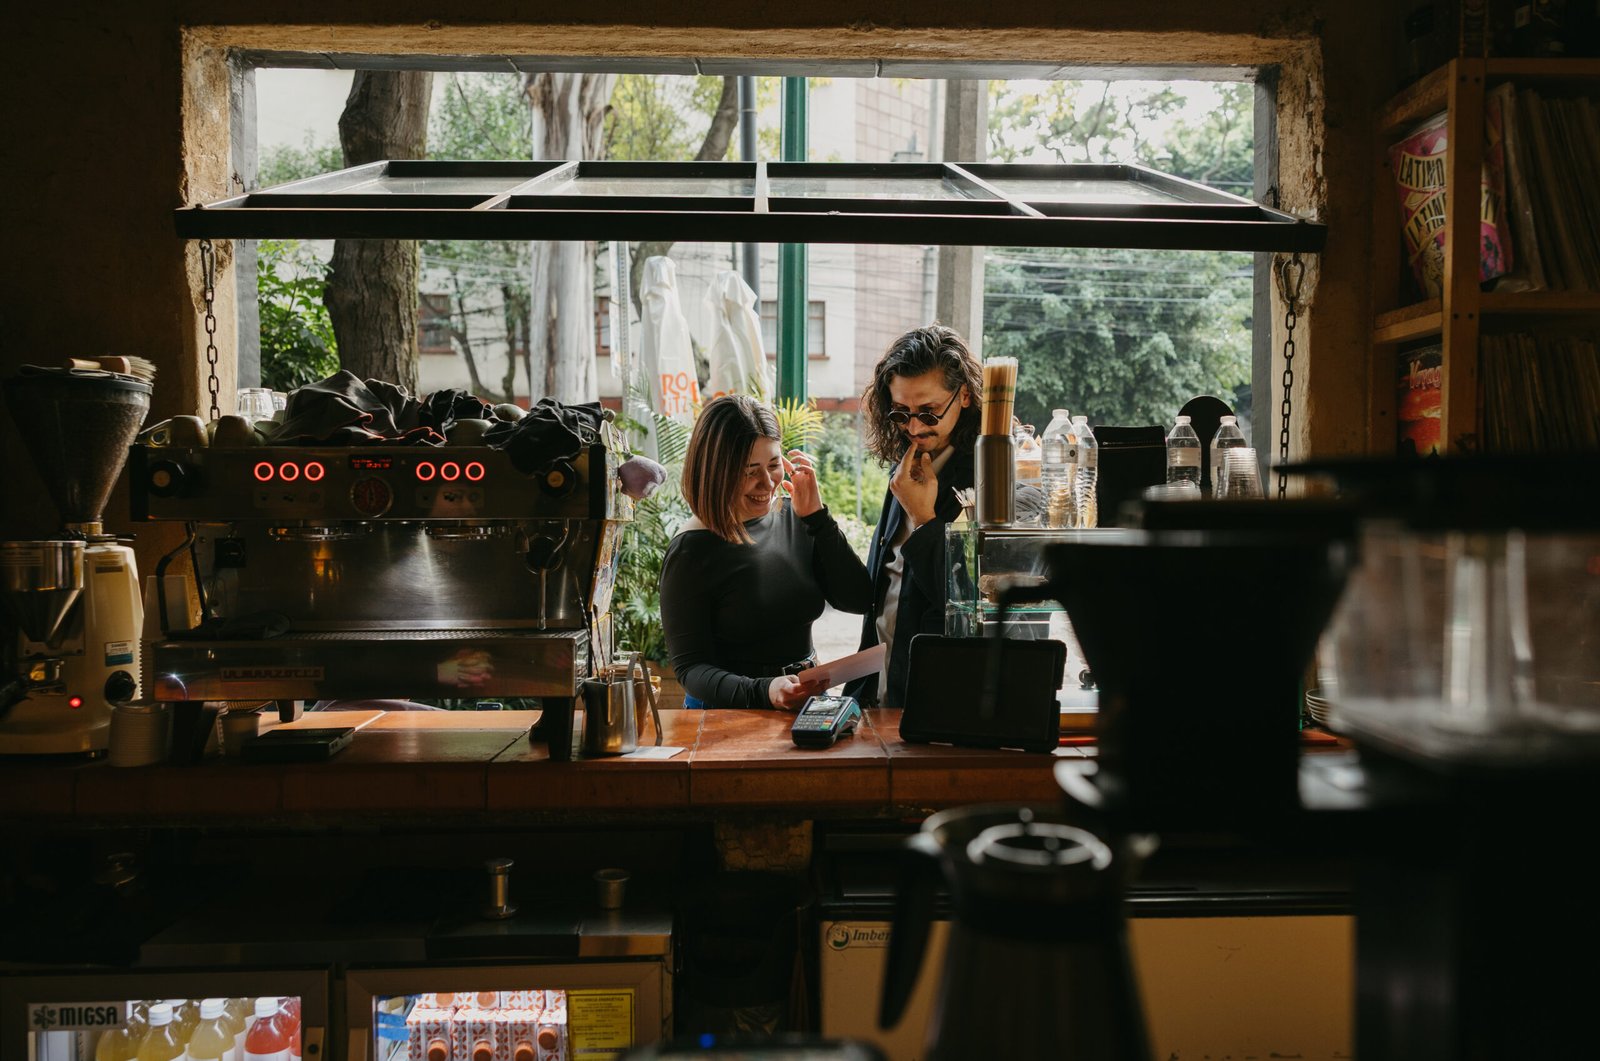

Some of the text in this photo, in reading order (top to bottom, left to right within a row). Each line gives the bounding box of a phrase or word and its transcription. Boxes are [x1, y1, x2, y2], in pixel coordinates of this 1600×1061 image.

[1399, 154, 1445, 188] LATINO
[1407, 192, 1446, 248] LATIN
[852, 929, 892, 941] Imber
[59, 1006, 118, 1026] MIGSA
